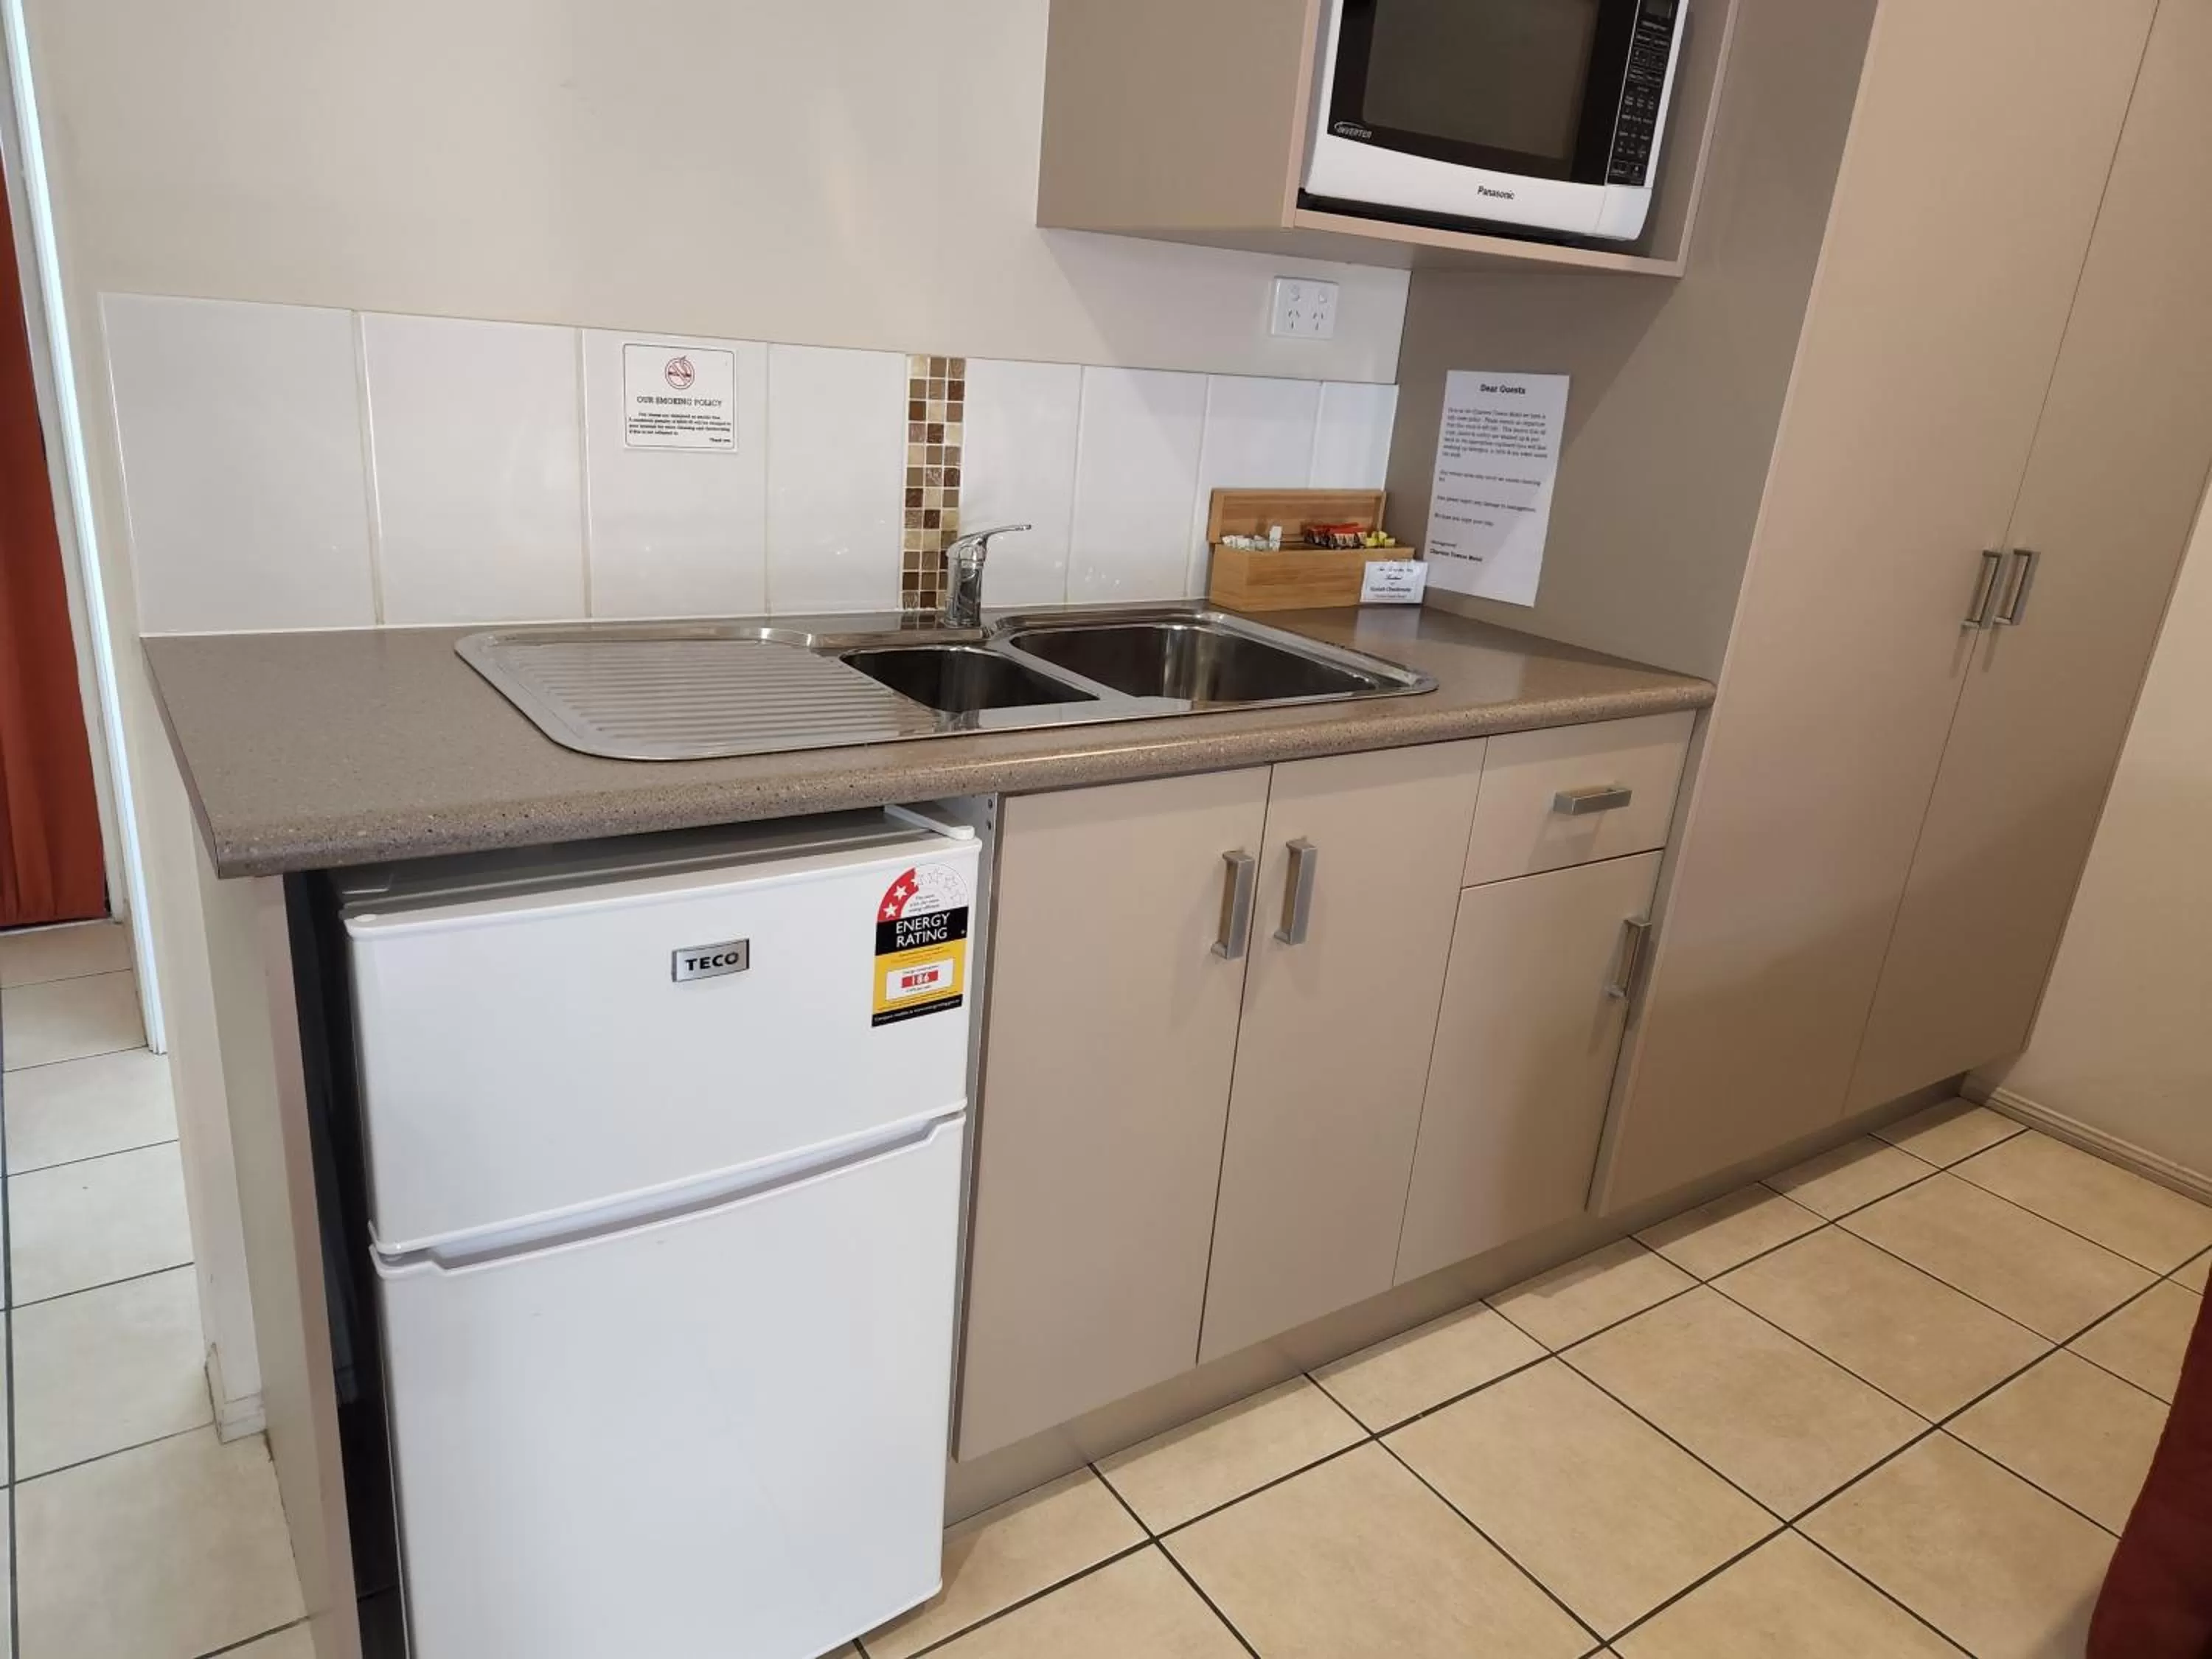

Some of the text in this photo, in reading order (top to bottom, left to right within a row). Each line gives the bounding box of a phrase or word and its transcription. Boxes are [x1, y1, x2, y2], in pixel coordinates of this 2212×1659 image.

[1477, 185, 1515, 200] Panasonic
[1480, 383, 1498, 393] Dear
[636, 396, 723, 408] OUR SMOKING POLICY
[896, 912, 950, 934] ENERGY
[896, 927, 947, 947] RATING
[684, 951, 739, 971] TECO
